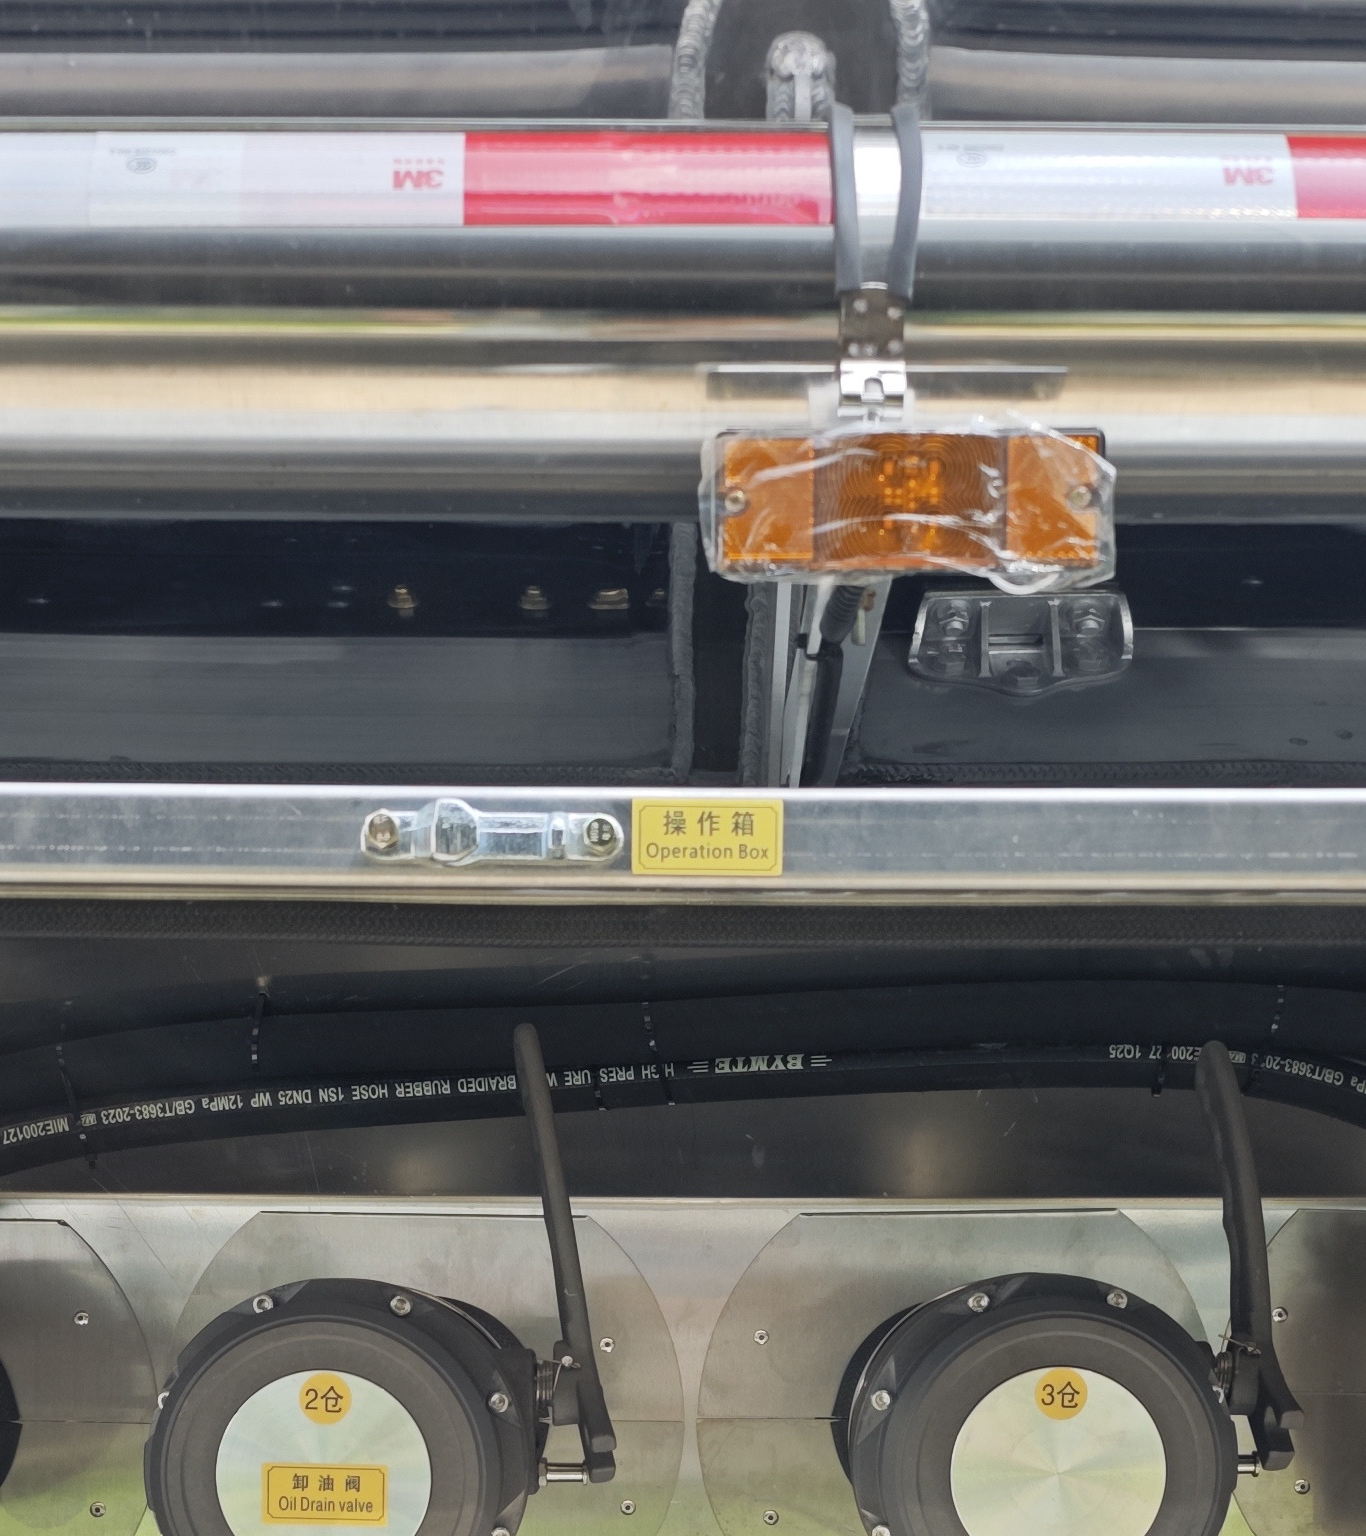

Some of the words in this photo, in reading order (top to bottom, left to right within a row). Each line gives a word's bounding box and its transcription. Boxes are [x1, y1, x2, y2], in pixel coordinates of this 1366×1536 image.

[391, 169, 444, 191] 3M
[662, 810, 755, 837] 操作箱
[646, 842, 733, 863] Operation
[738, 843, 769, 861] Box
[1108, 1044, 1141, 1058] 1Q25
[642, 1063, 675, 1078] HGH
[715, 1054, 804, 1073] BYMTE
[1251, 1052, 1344, 1086] GB/T3683-203
[351, 1083, 388, 1099] HOSE
[396, 1080, 451, 1097] RUBBER
[458, 1074, 517, 1093] BRAIDED
[202, 1094, 243, 1111] 12MPa
[251, 1092, 272, 1107] WP
[278, 1089, 312, 1105] DN25
[319, 1087, 344, 1103] 1SN
[101, 1099, 195, 1124] GB/T3683-2023
[304, 1386, 343, 1414] 2仓
[1041, 1381, 1080, 1408] 3仓
[292, 1474, 362, 1493] 卸油阀
[278, 1495, 297, 1513] Oil
[300, 1496, 335, 1514] Drain
[338, 1497, 373, 1514] valve
